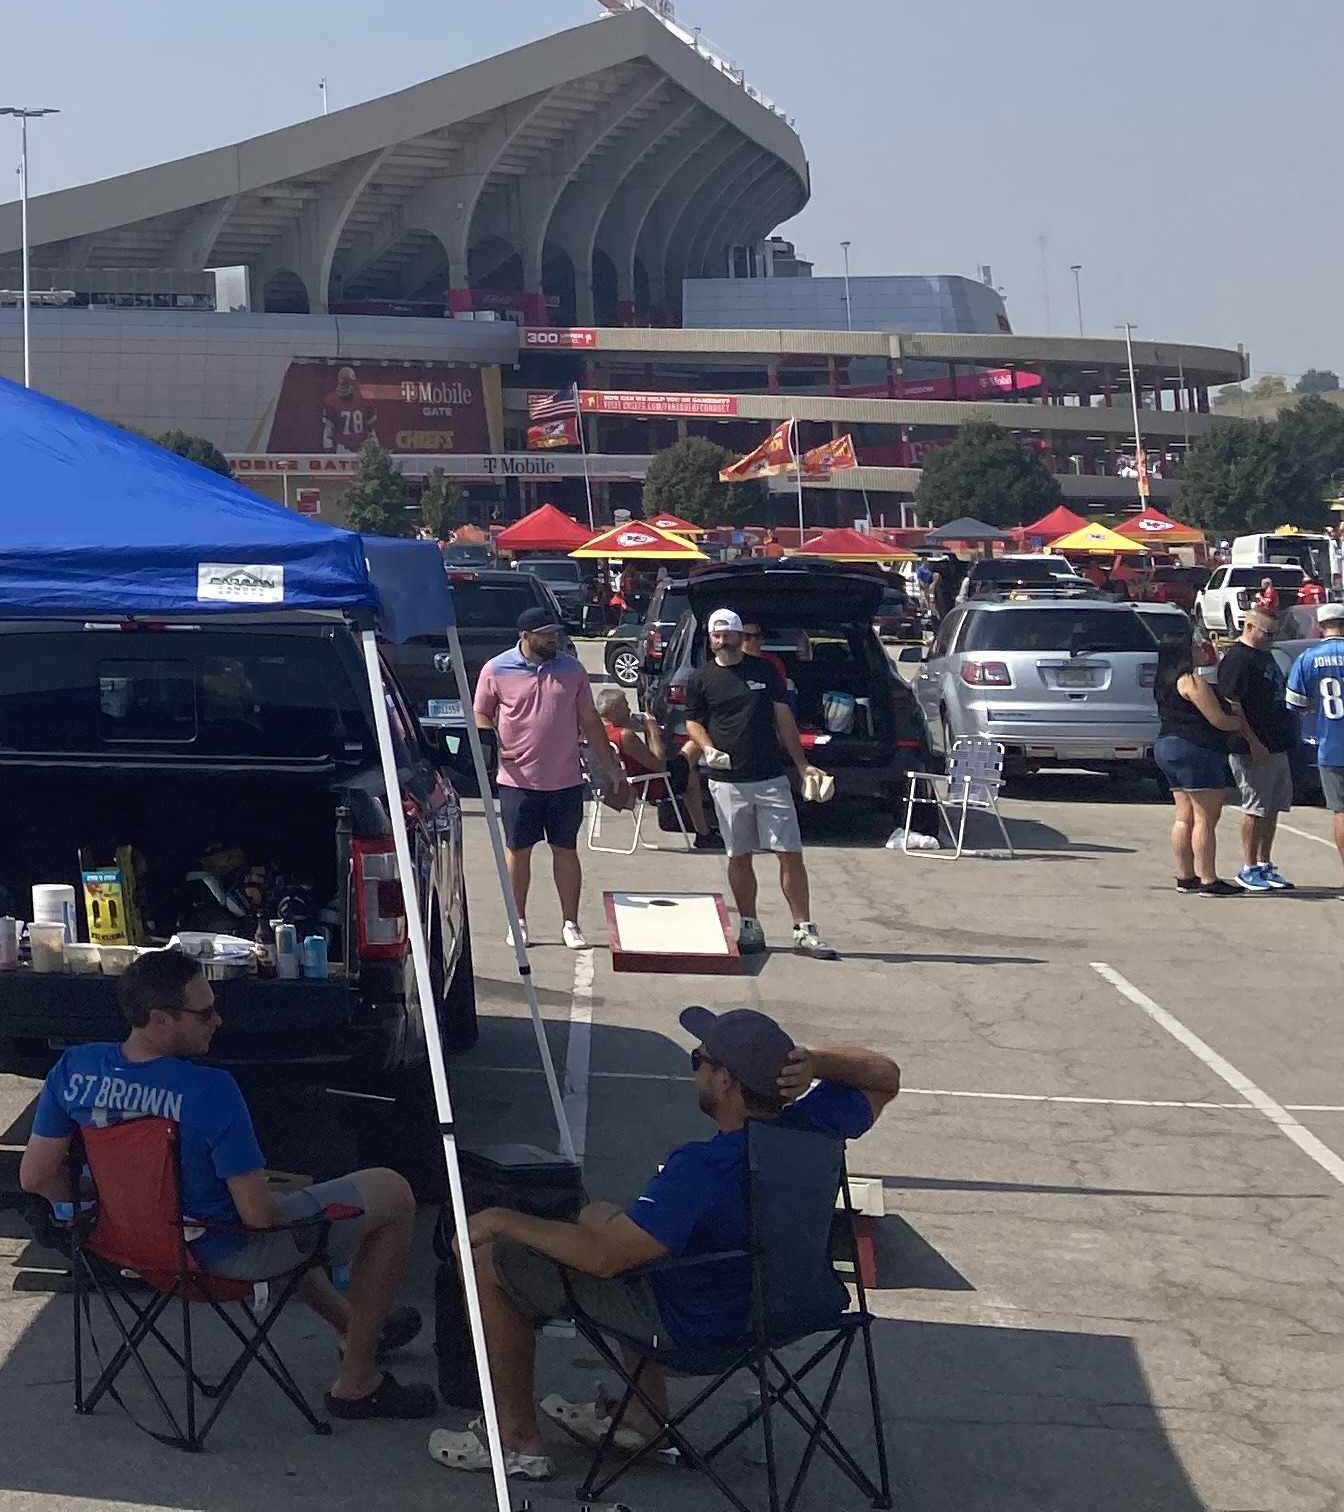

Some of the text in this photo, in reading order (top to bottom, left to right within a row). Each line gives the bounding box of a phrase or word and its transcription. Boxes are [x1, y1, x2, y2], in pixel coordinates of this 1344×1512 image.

[527, 333, 558, 343] 300
[422, 407, 453, 417] GATE
[340, 409, 363, 435] 78
[500, 458, 555, 474] Mobile
[1314, 655, 1344, 668] JOHNS
[1319, 677, 1344, 720] 8
[63, 1073, 97, 1106] ST
[94, 1076, 183, 1122] BROWN
